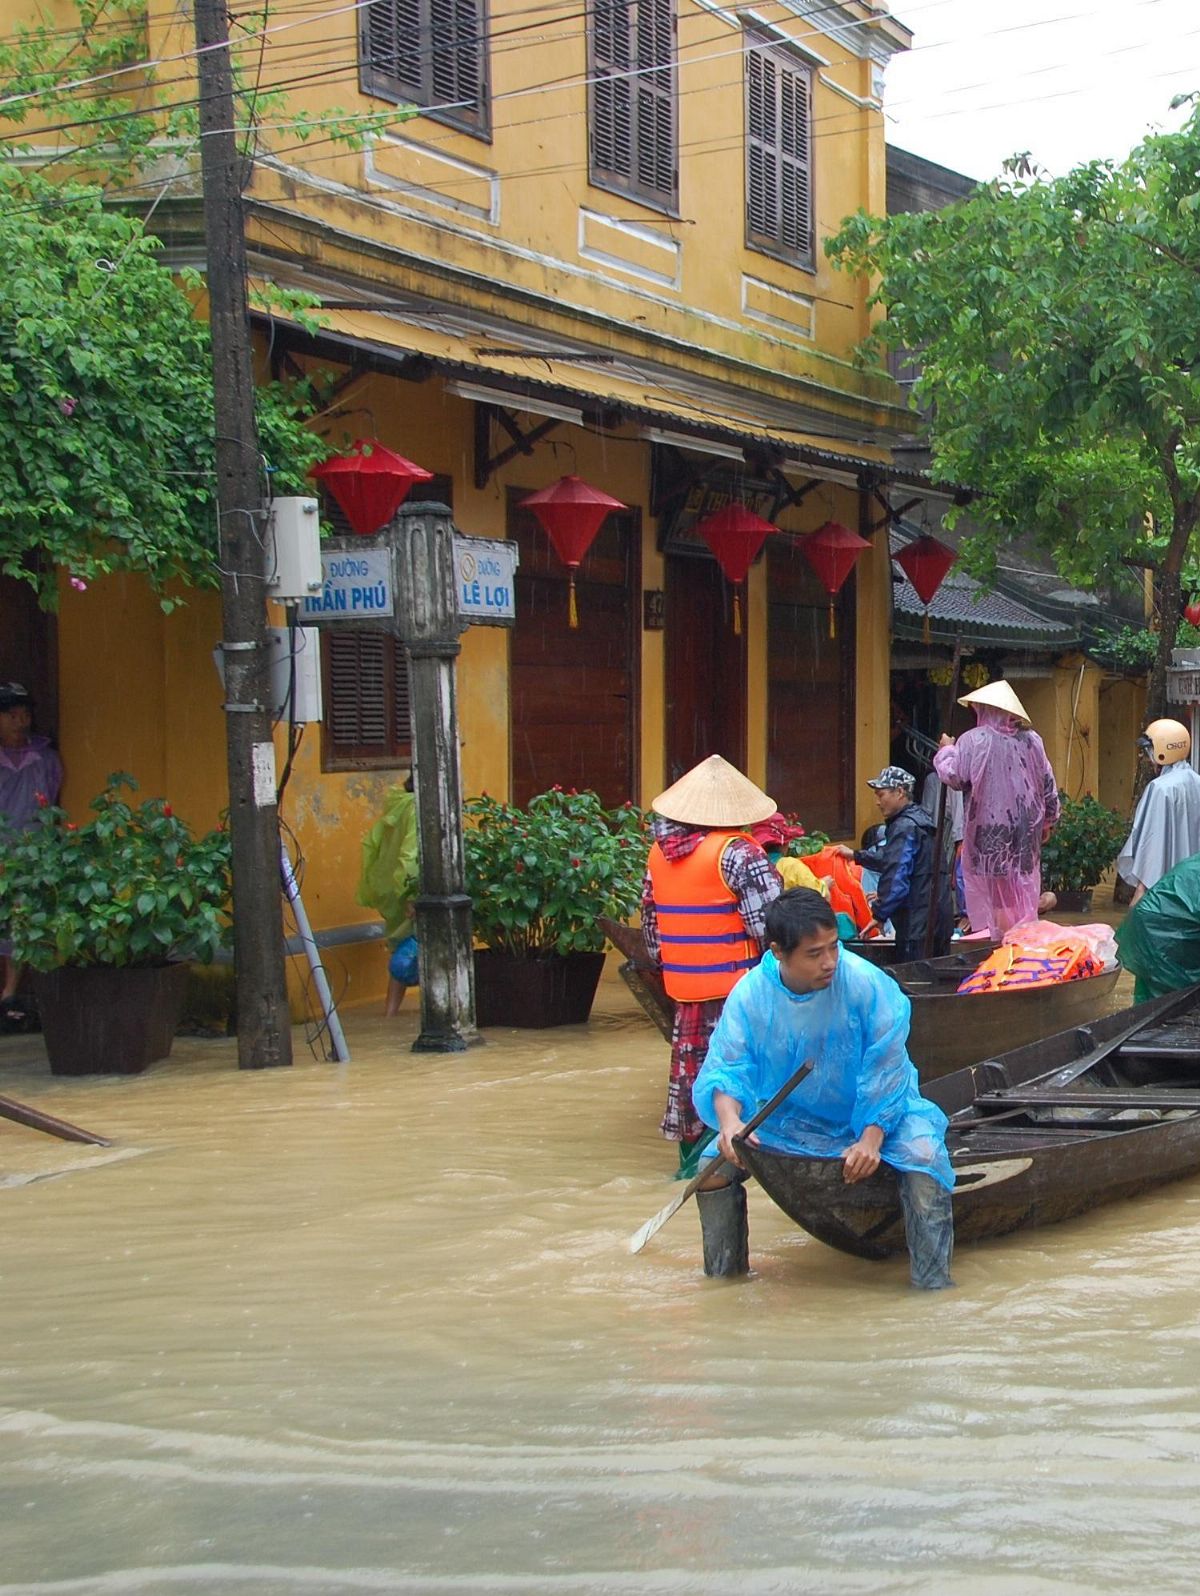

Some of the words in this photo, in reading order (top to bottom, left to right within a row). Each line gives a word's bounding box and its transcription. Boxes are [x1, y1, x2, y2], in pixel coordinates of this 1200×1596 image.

[351, 580, 386, 609] PHÚ
[463, 580, 481, 605] LÊ
[485, 585, 509, 613] LỢI
